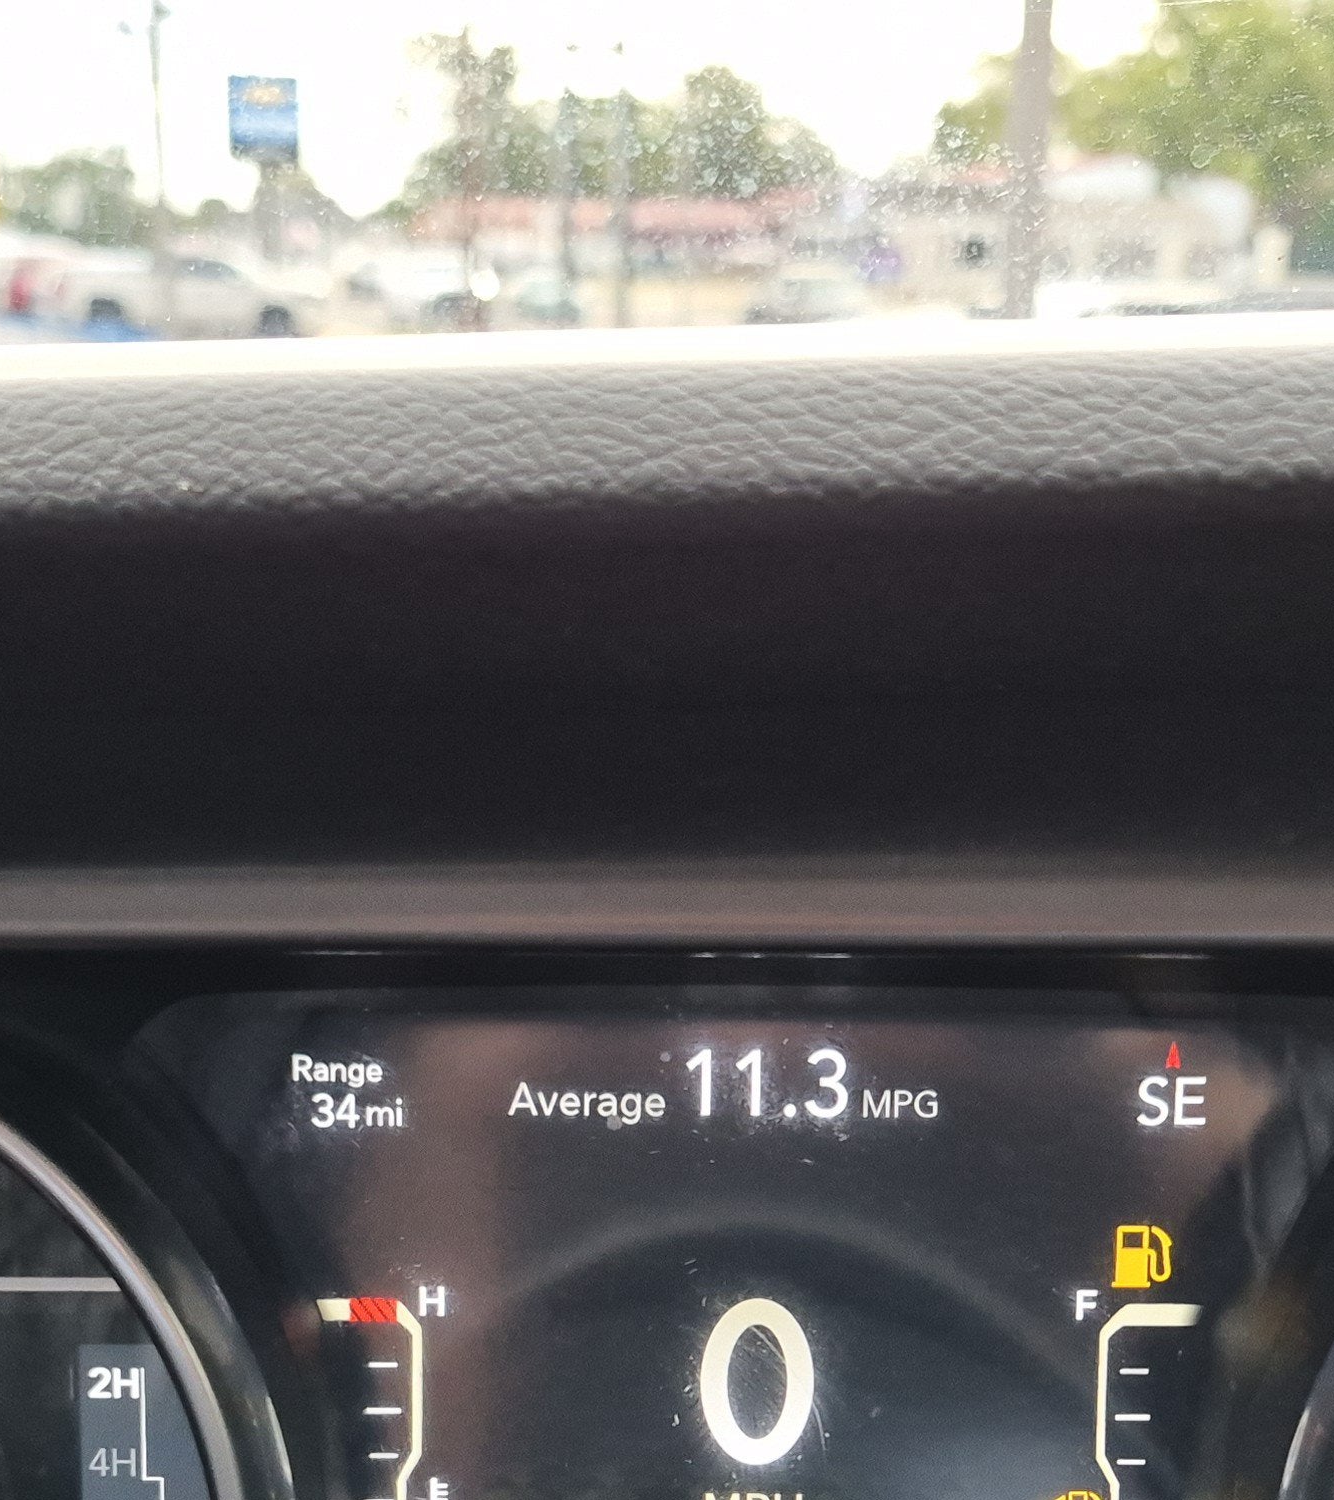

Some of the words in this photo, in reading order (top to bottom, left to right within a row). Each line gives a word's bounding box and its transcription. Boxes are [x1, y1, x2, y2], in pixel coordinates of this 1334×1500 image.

[290, 1052, 385, 1090] Range
[506, 1080, 667, 1130] Average
[685, 1047, 850, 1120] 11.3
[861, 1087, 940, 1121] MPG
[310, 1092, 358, 1130] 34
[364, 1095, 404, 1129] mi
[1136, 1075, 1208, 1128] SE
[417, 1284, 447, 1319] H
[1073, 1288, 1099, 1322] F
[86, 1365, 142, 1401] 2H
[699, 1297, 816, 1467] 0
[87, 1446, 138, 1478] 4H
